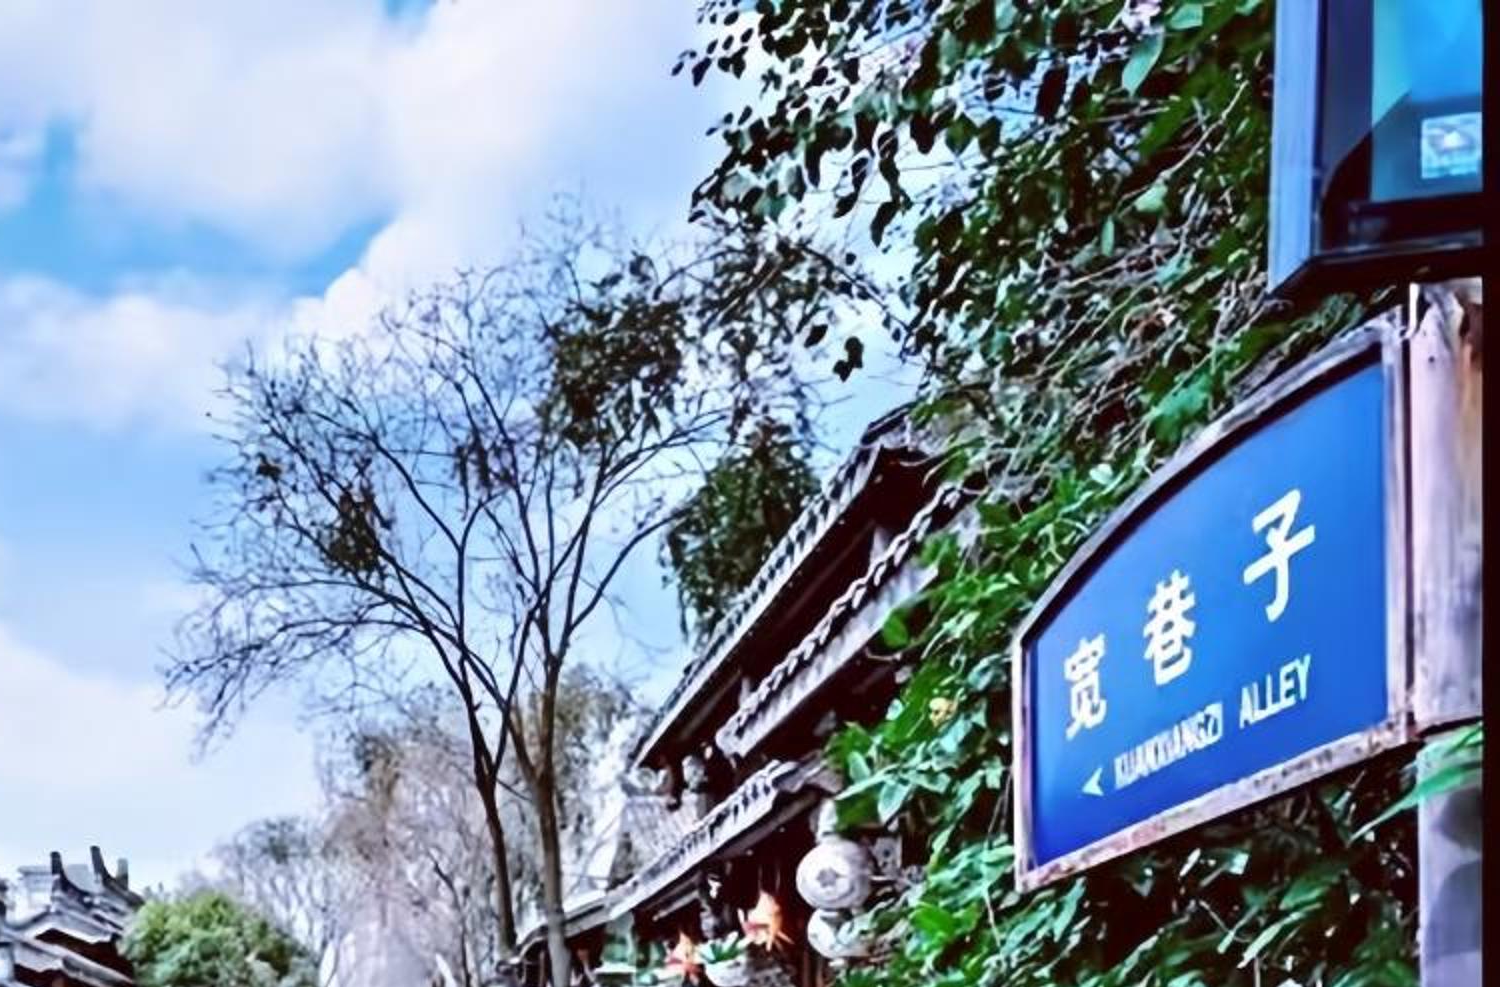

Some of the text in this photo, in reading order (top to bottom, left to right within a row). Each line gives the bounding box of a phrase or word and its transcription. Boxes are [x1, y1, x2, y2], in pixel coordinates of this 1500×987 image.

[1063, 489, 1316, 740] 宽巷子
[1239, 654, 1311, 729] ALLEY
